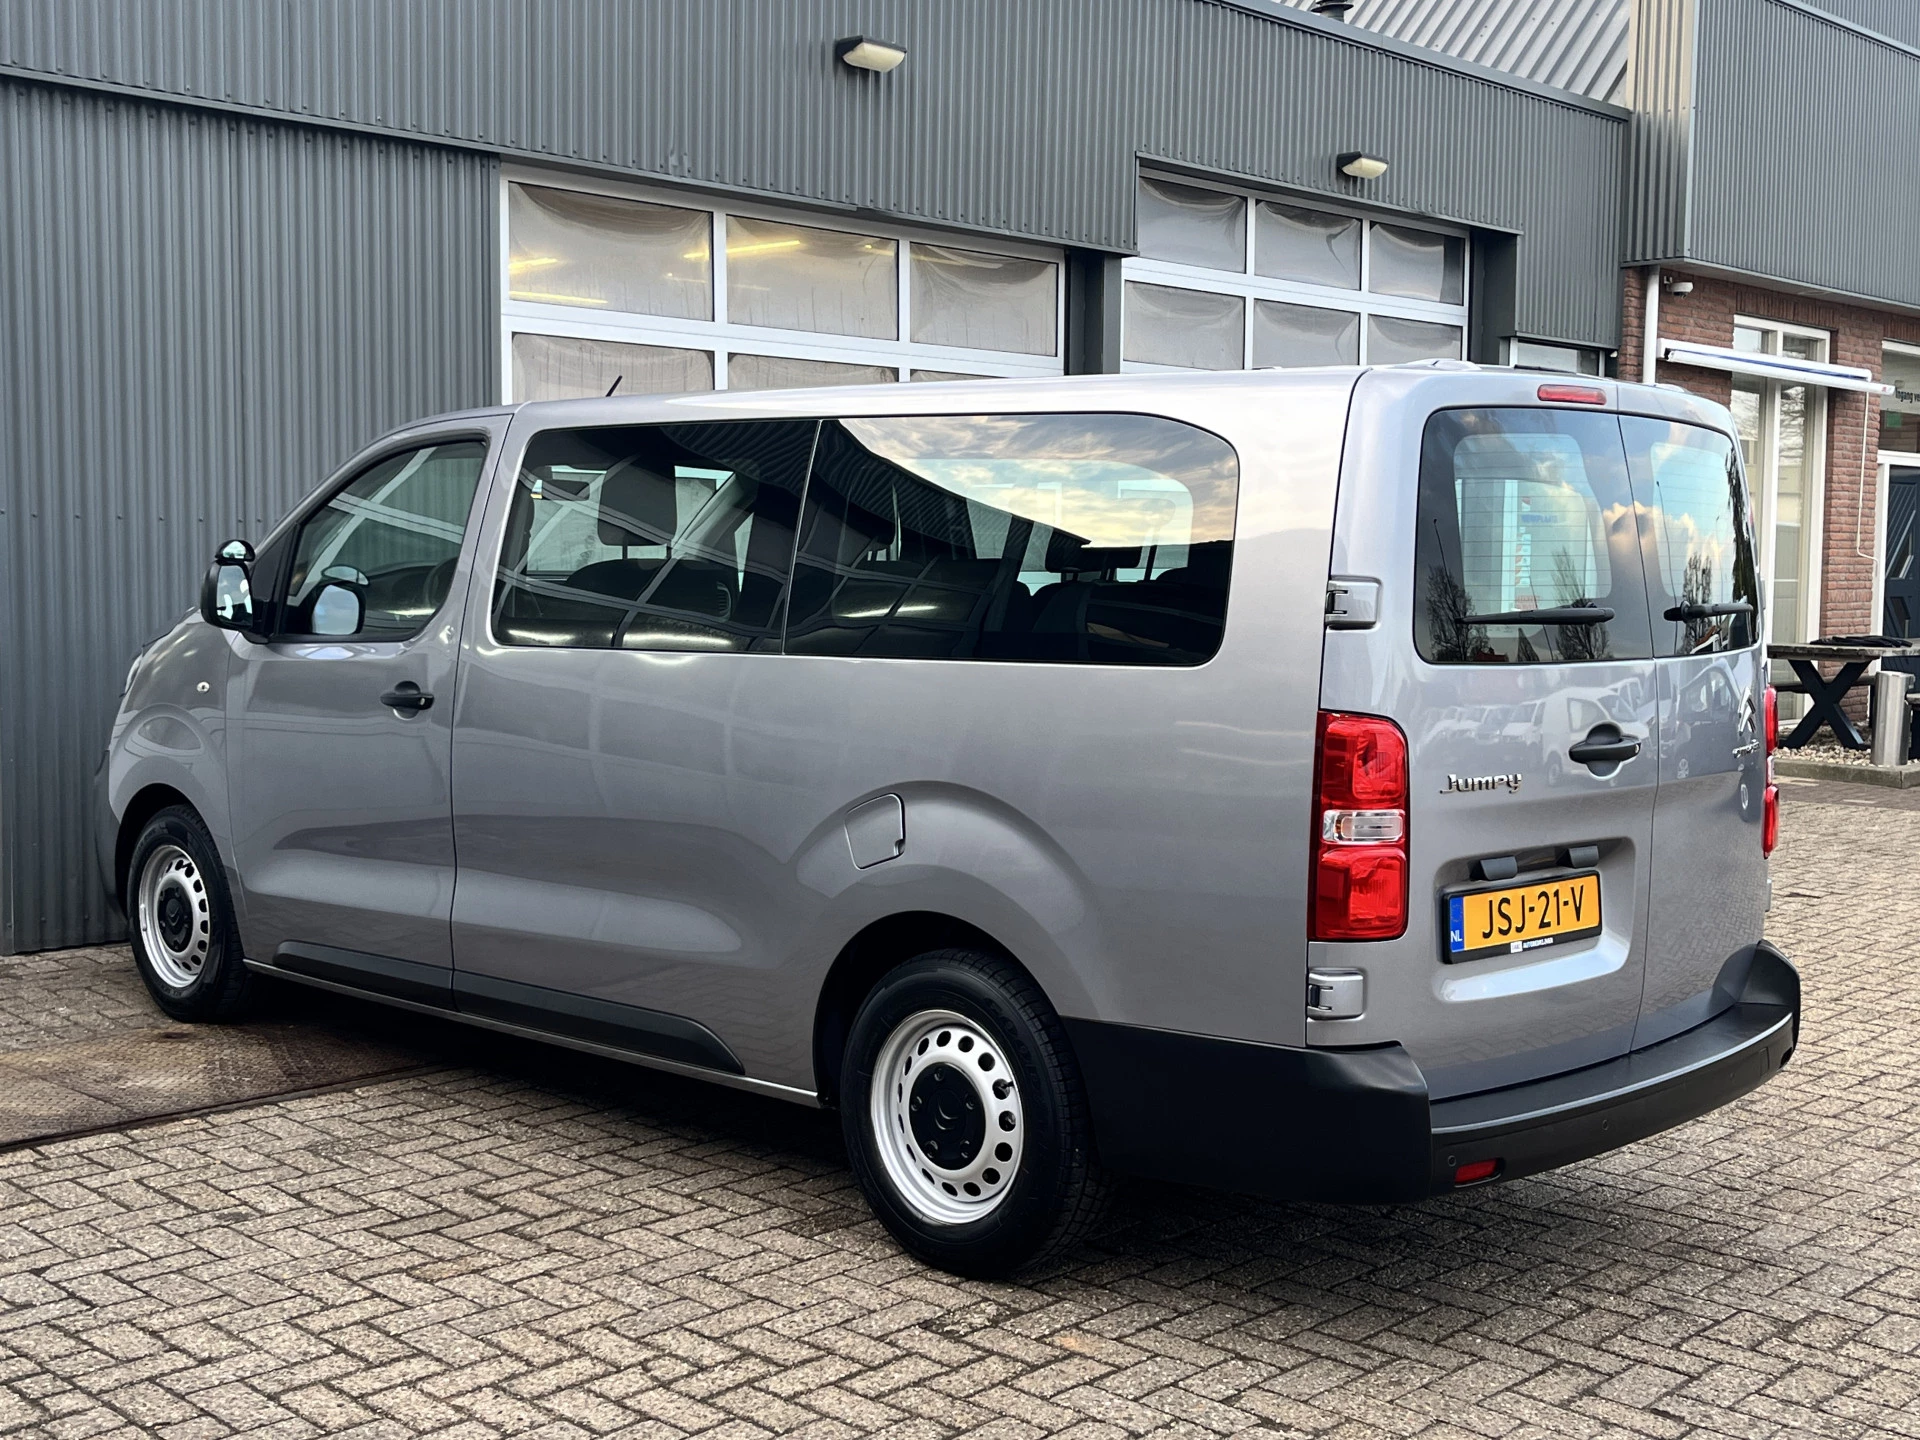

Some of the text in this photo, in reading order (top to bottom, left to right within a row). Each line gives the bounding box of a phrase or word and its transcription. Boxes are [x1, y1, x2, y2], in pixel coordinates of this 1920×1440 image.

[1439, 773, 1522, 794] Jumpy
[1482, 885, 1584, 938] JSJ-21-V
[1450, 929, 1463, 943] NL
